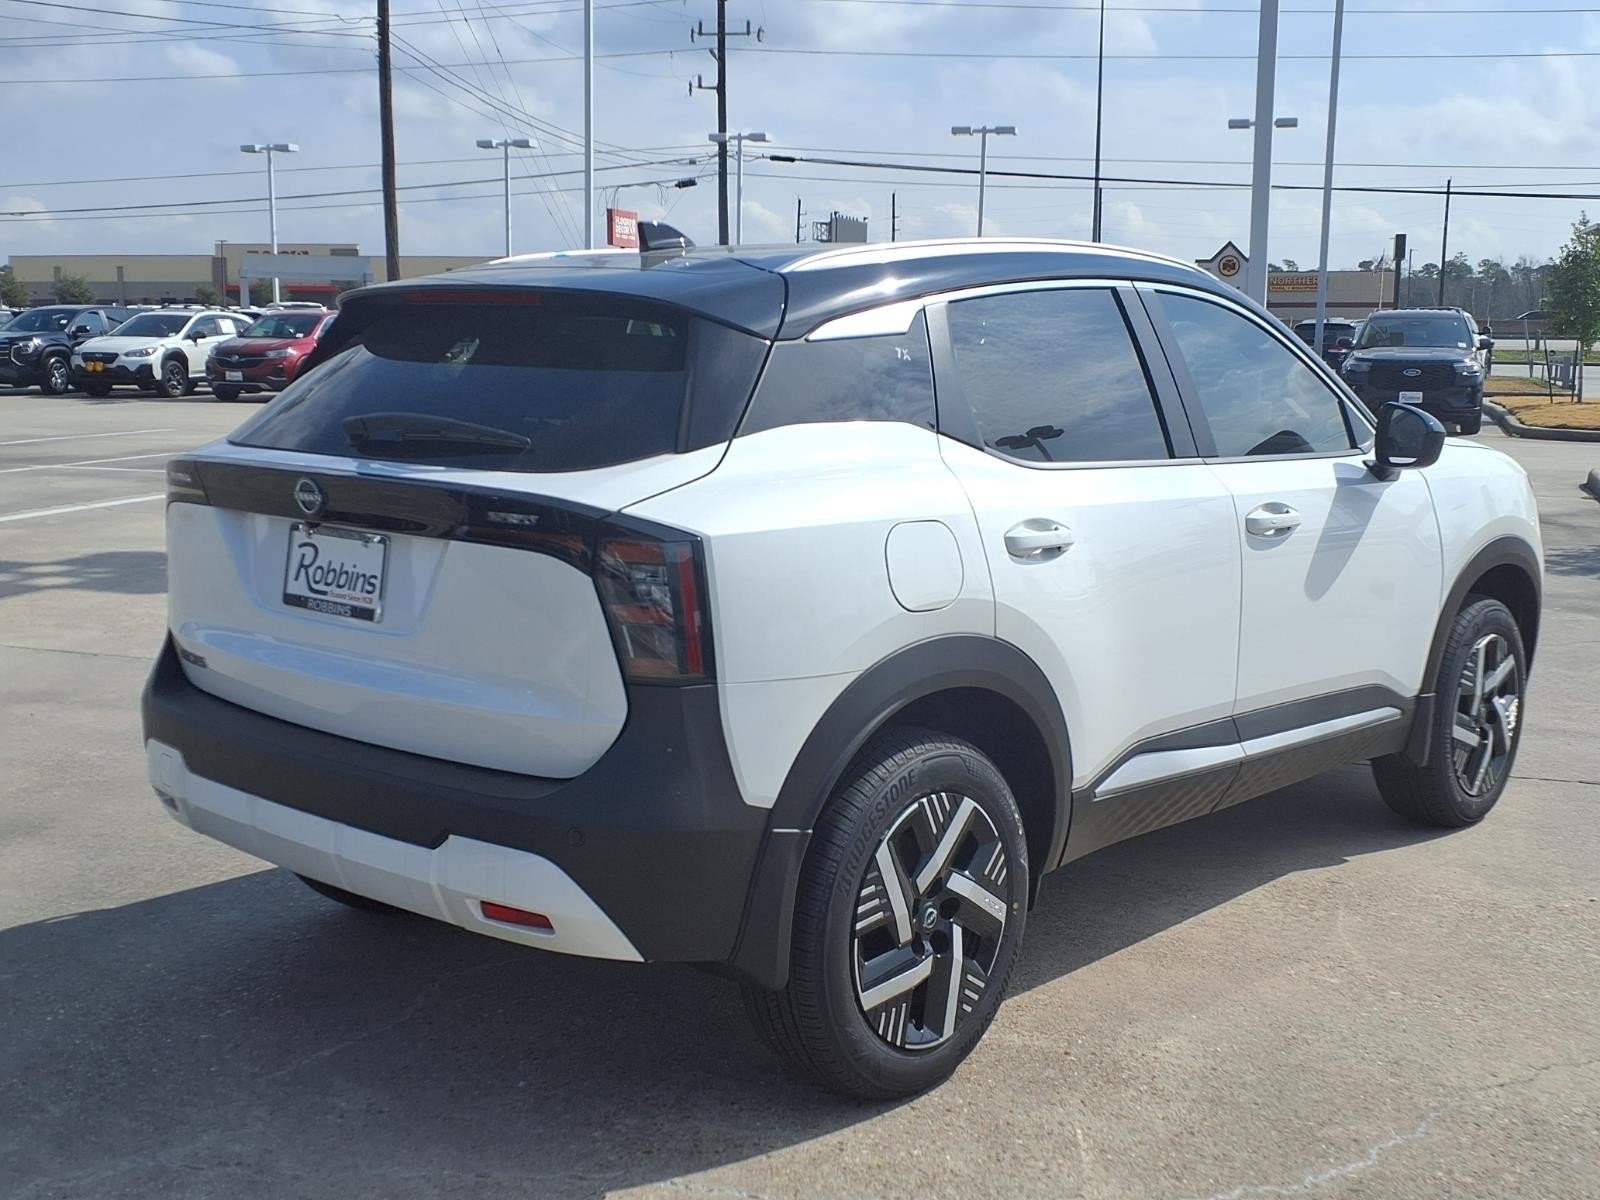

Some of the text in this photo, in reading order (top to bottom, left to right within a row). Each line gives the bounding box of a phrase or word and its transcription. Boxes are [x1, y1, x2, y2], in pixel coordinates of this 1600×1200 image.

[1270, 277, 1319, 285] NORTHER
[294, 542, 378, 595] Robbins
[307, 599, 352, 617] ROBBINS
